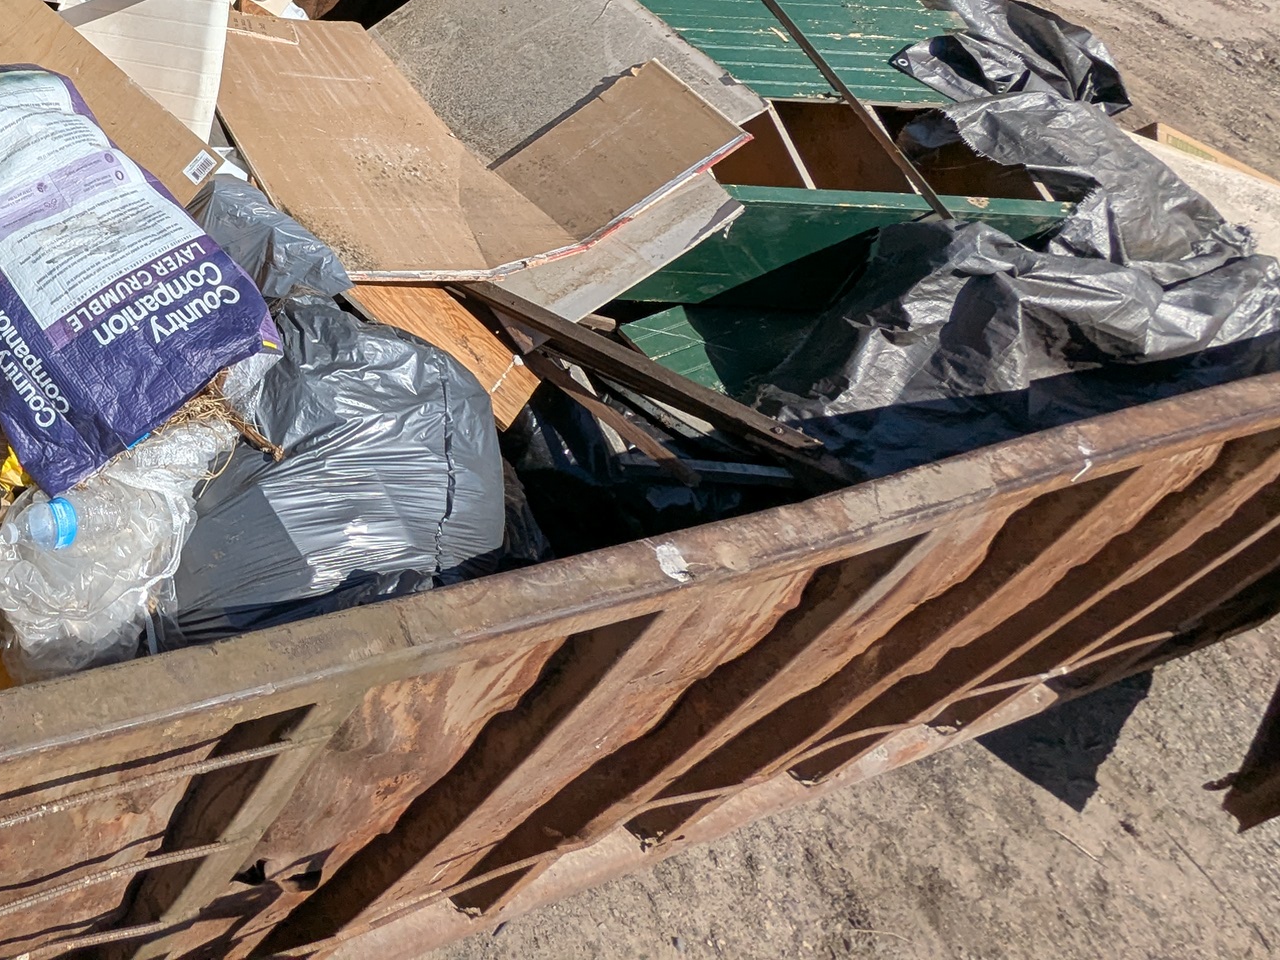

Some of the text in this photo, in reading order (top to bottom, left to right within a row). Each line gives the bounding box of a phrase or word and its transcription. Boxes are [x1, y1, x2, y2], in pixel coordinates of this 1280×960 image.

[151, 240, 206, 278] LAYER
[65, 269, 150, 332] CRUMBLE
[92, 261, 220, 348] Companion
[151, 284, 239, 344] Country
